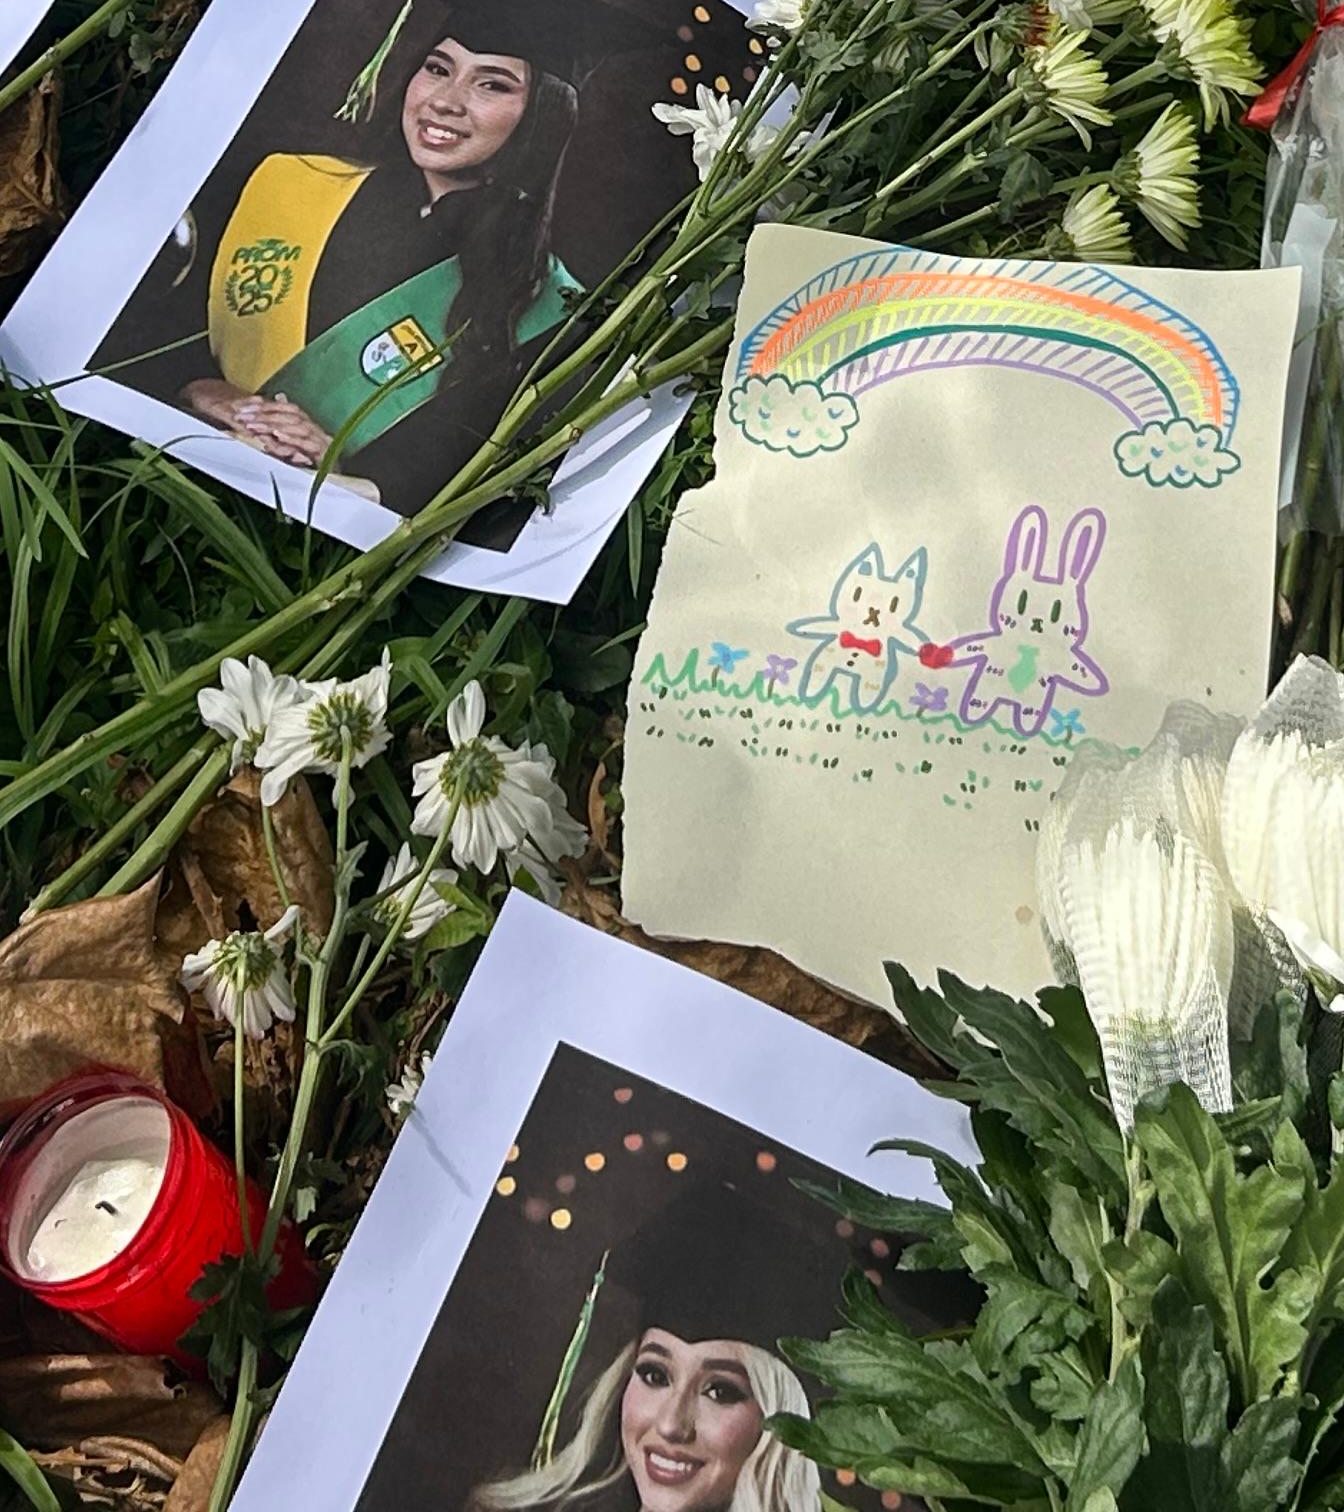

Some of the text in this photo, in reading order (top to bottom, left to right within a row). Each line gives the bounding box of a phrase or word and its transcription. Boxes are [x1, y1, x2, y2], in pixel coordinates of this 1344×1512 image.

[231, 243, 302, 265] PROM
[240, 264, 279, 291] 20
[237, 290, 274, 316] 25
